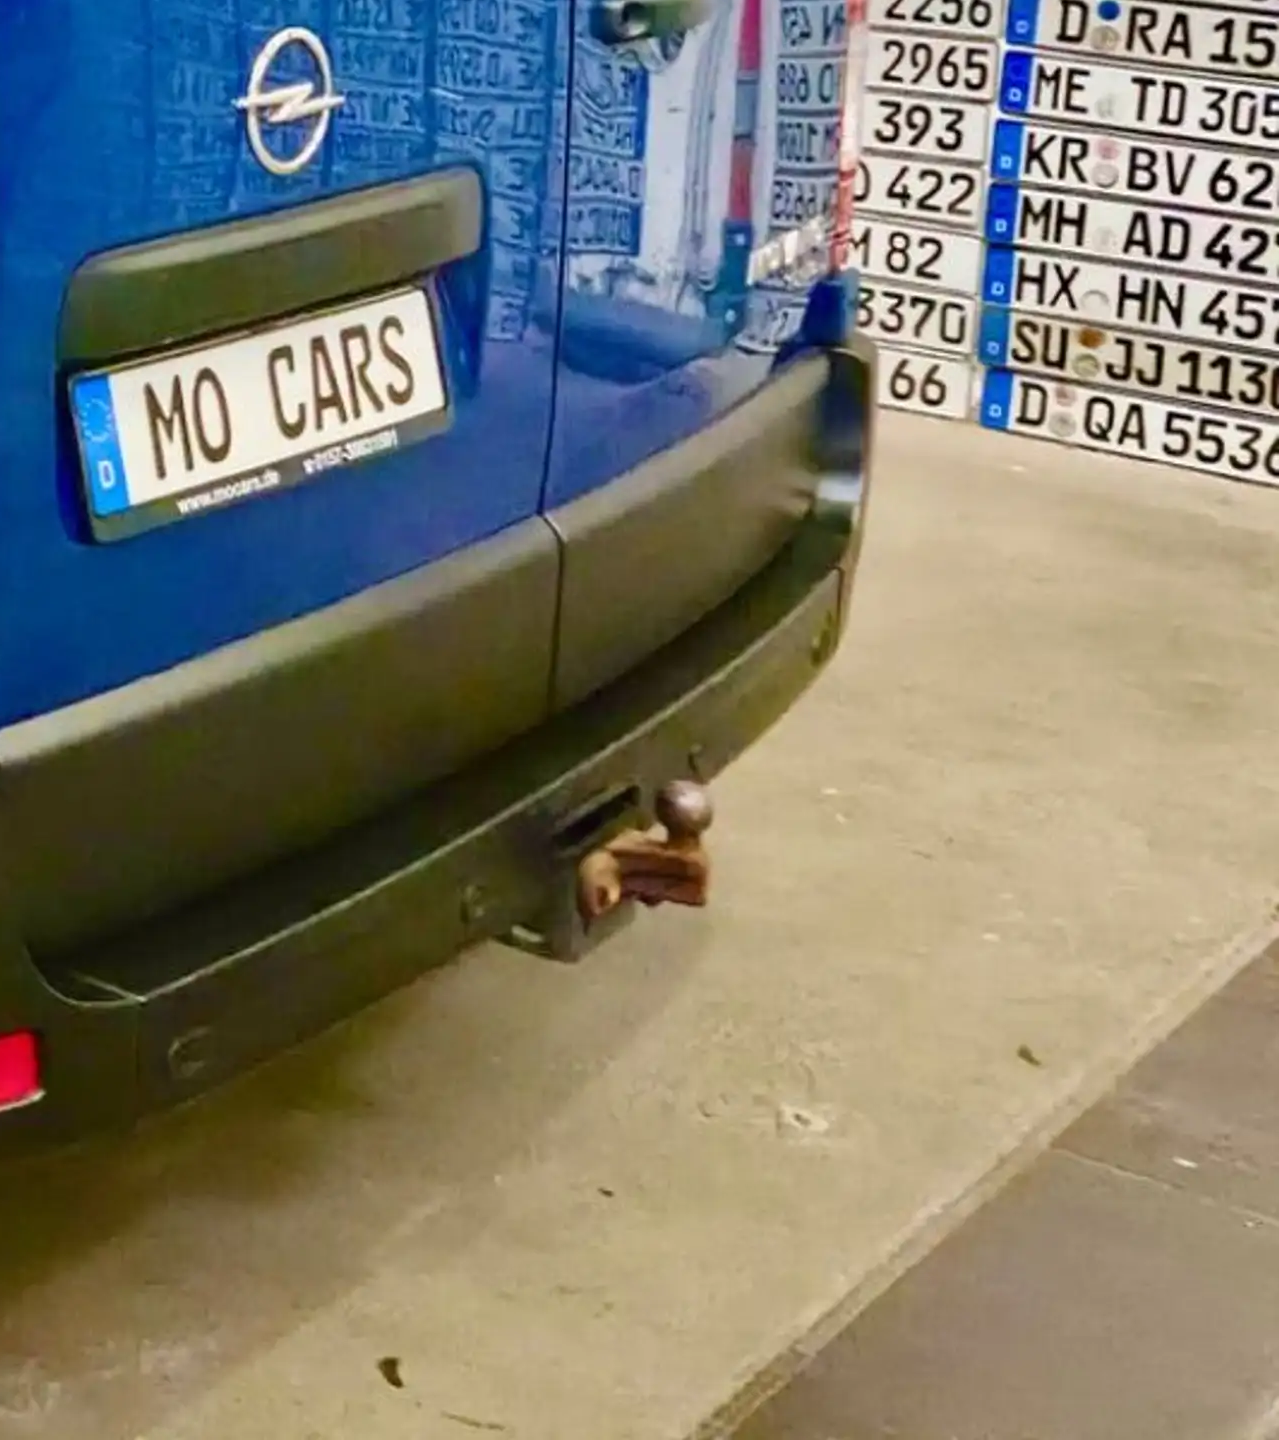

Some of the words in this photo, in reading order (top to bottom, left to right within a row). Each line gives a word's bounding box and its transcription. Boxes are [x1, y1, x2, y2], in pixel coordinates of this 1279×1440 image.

[881, 40, 990, 91] 2965
[1125, 6, 1192, 59] RA
[1208, 18, 1279, 68] 15
[874, 100, 965, 151] 393
[1007, 87, 1022, 102] D
[1033, 64, 1091, 113] ME
[1131, 76, 1188, 127] TD
[1199, 85, 1279, 139] 305
[885, 165, 976, 216] 422
[1000, 156, 1013, 170] D
[1023, 131, 1090, 184] KR
[1126, 145, 1196, 197] BV
[1208, 158, 1279, 210] 62
[885, 231, 944, 281] 82
[995, 218, 1007, 233] D
[1018, 195, 1088, 247] MH
[1122, 210, 1191, 262] AD
[1204, 223, 1279, 276] 42
[990, 281, 1005, 296] D
[1015, 258, 1081, 311] HX
[1116, 273, 1186, 330] HN
[1199, 289, 1279, 345] 45
[888, 358, 947, 407] 66
[1010, 319, 1070, 371] SU
[1105, 337, 1166, 388] JJ
[98, 458, 117, 491] D
[143, 364, 233, 480] MO
[266, 313, 416, 441] CARS
[989, 403, 1002, 418] D
[1015, 380, 1048, 427] D
[1083, 396, 1147, 450] QA
